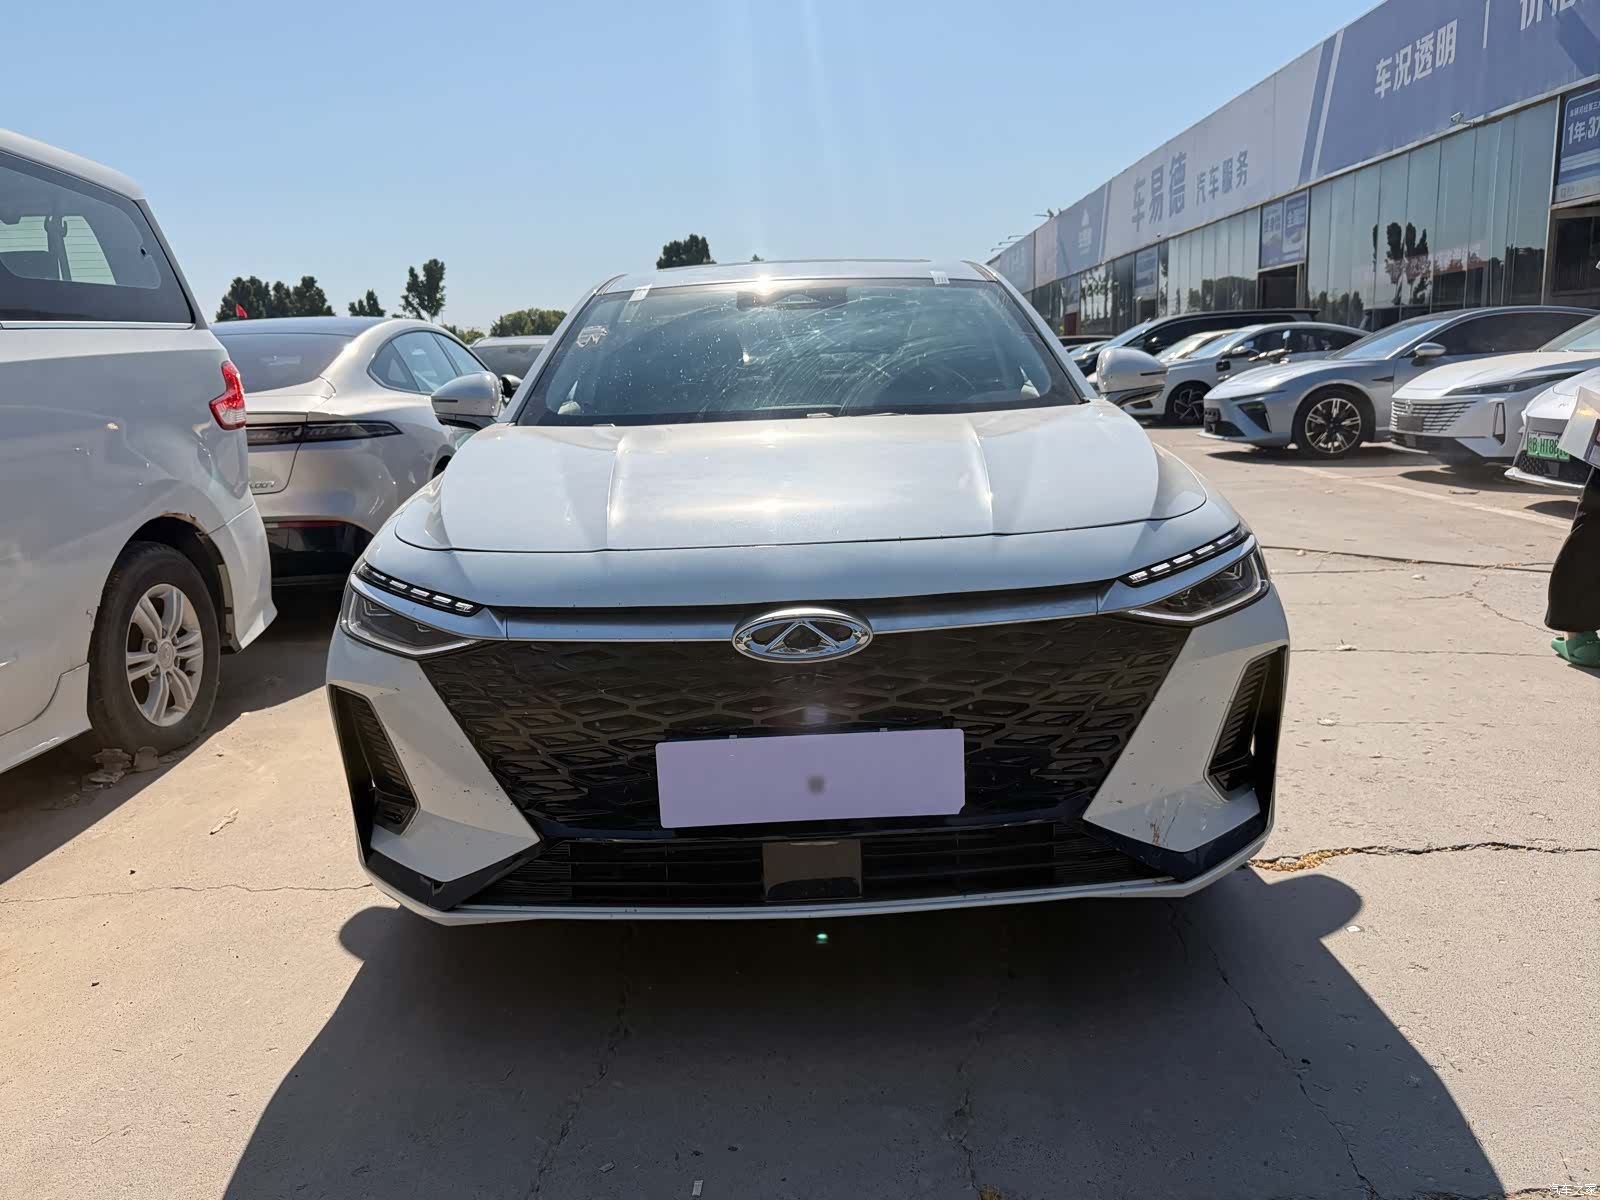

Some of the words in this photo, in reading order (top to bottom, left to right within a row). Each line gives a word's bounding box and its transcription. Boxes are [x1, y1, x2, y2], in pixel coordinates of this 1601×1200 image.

[1374, 18, 1458, 99] 车况透明
[1132, 151, 1187, 232] 车易德
[1196, 150, 1249, 206] 汽车服务
